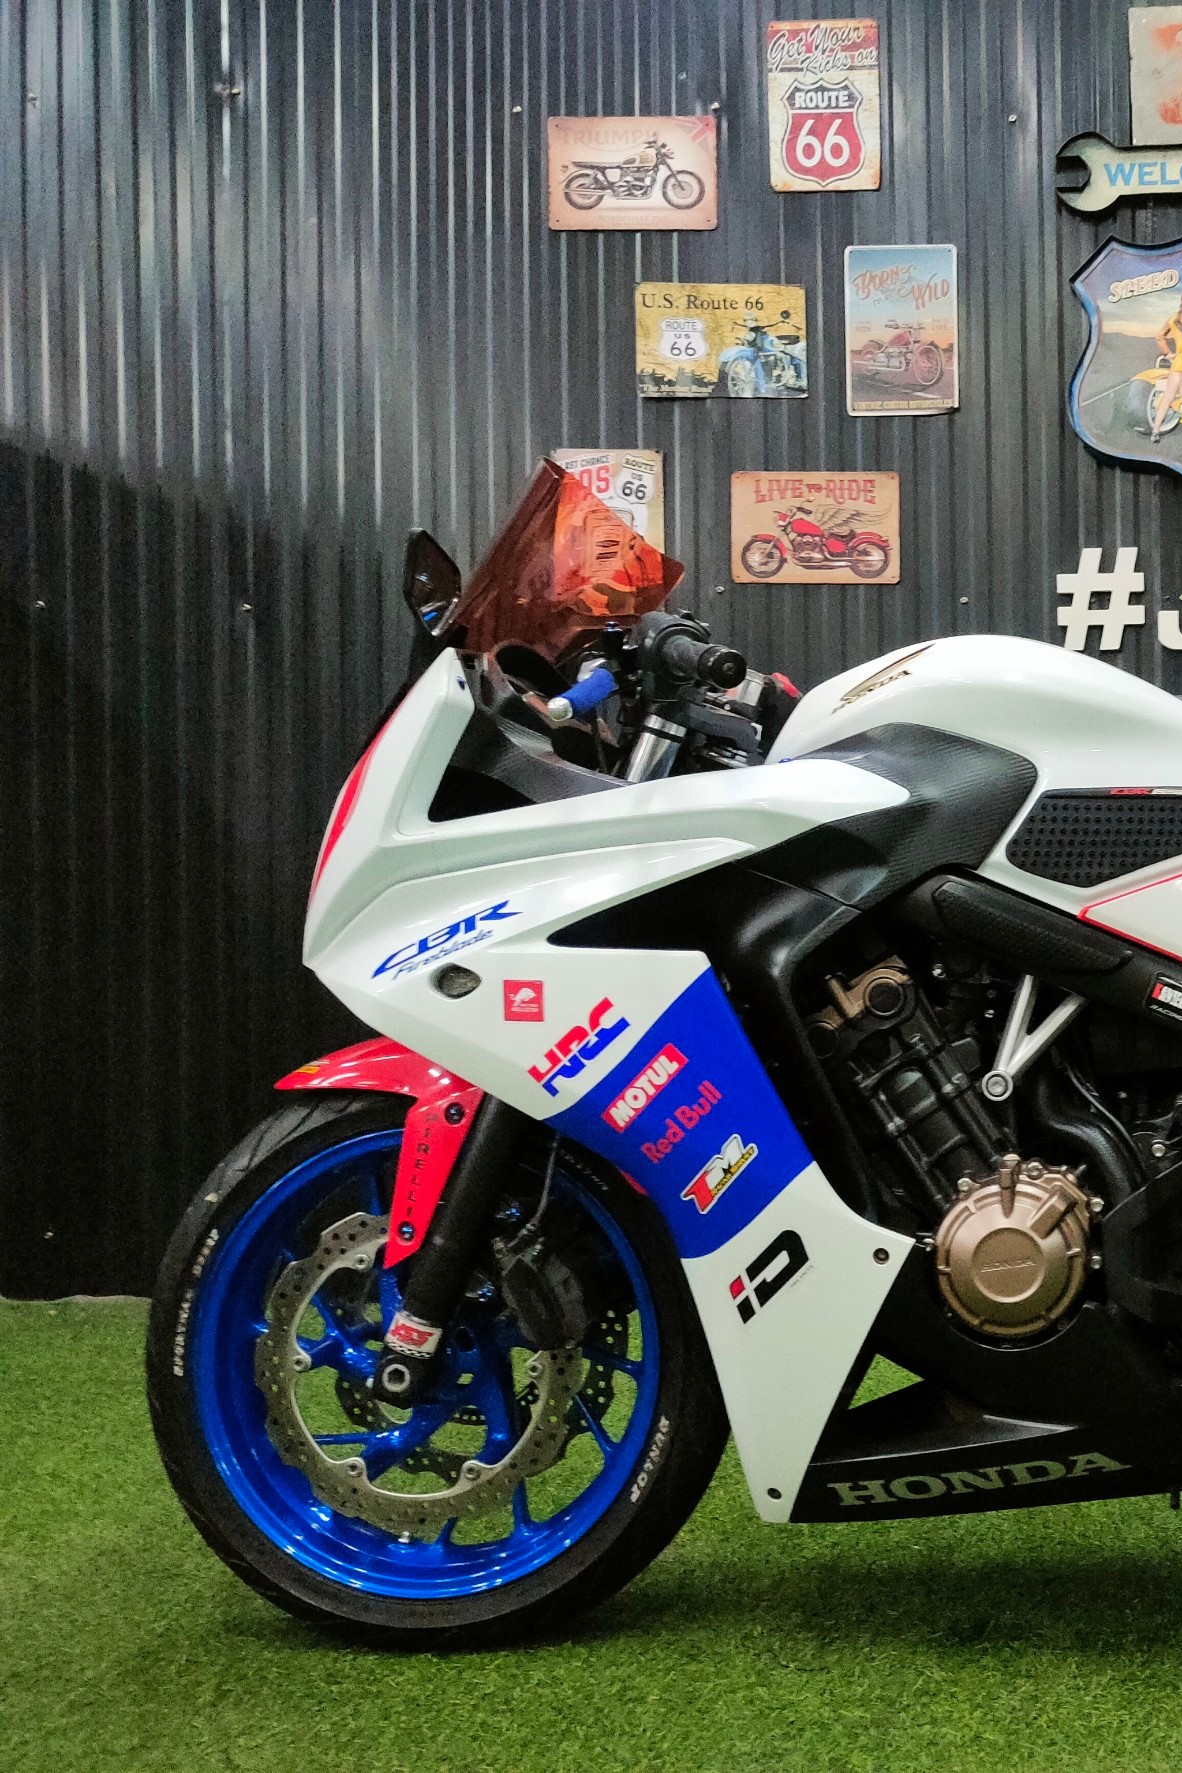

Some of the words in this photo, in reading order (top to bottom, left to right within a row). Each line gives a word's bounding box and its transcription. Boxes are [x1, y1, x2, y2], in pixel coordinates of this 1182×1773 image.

[769, 31, 806, 73] Get
[808, 23, 864, 54] Your
[800, 49, 850, 78] Kicks
[855, 46, 878, 64] on
[794, 90, 849, 109] ROUTE
[795, 118, 850, 168] 66
[640, 293, 680, 309] U.S.
[686, 294, 739, 311] Route
[745, 296, 765, 311] 66
[1108, 269, 1180, 303] SPEED
[664, 320, 698, 331] ROUTE
[670, 341, 697, 357] 66
[623, 458, 656, 472] ROUTE
[622, 480, 648, 500] 66
[753, 479, 804, 505] LIVE
[824, 479, 877, 505] RIDE
[371, 900, 524, 979] CBR
[527, 997, 631, 1098] HRC
[608, 1051, 681, 1128] MOTUL
[641, 1118, 686, 1164] Red
[674, 1080, 723, 1130] Bull
[827, 1451, 1133, 1506] HONDA
